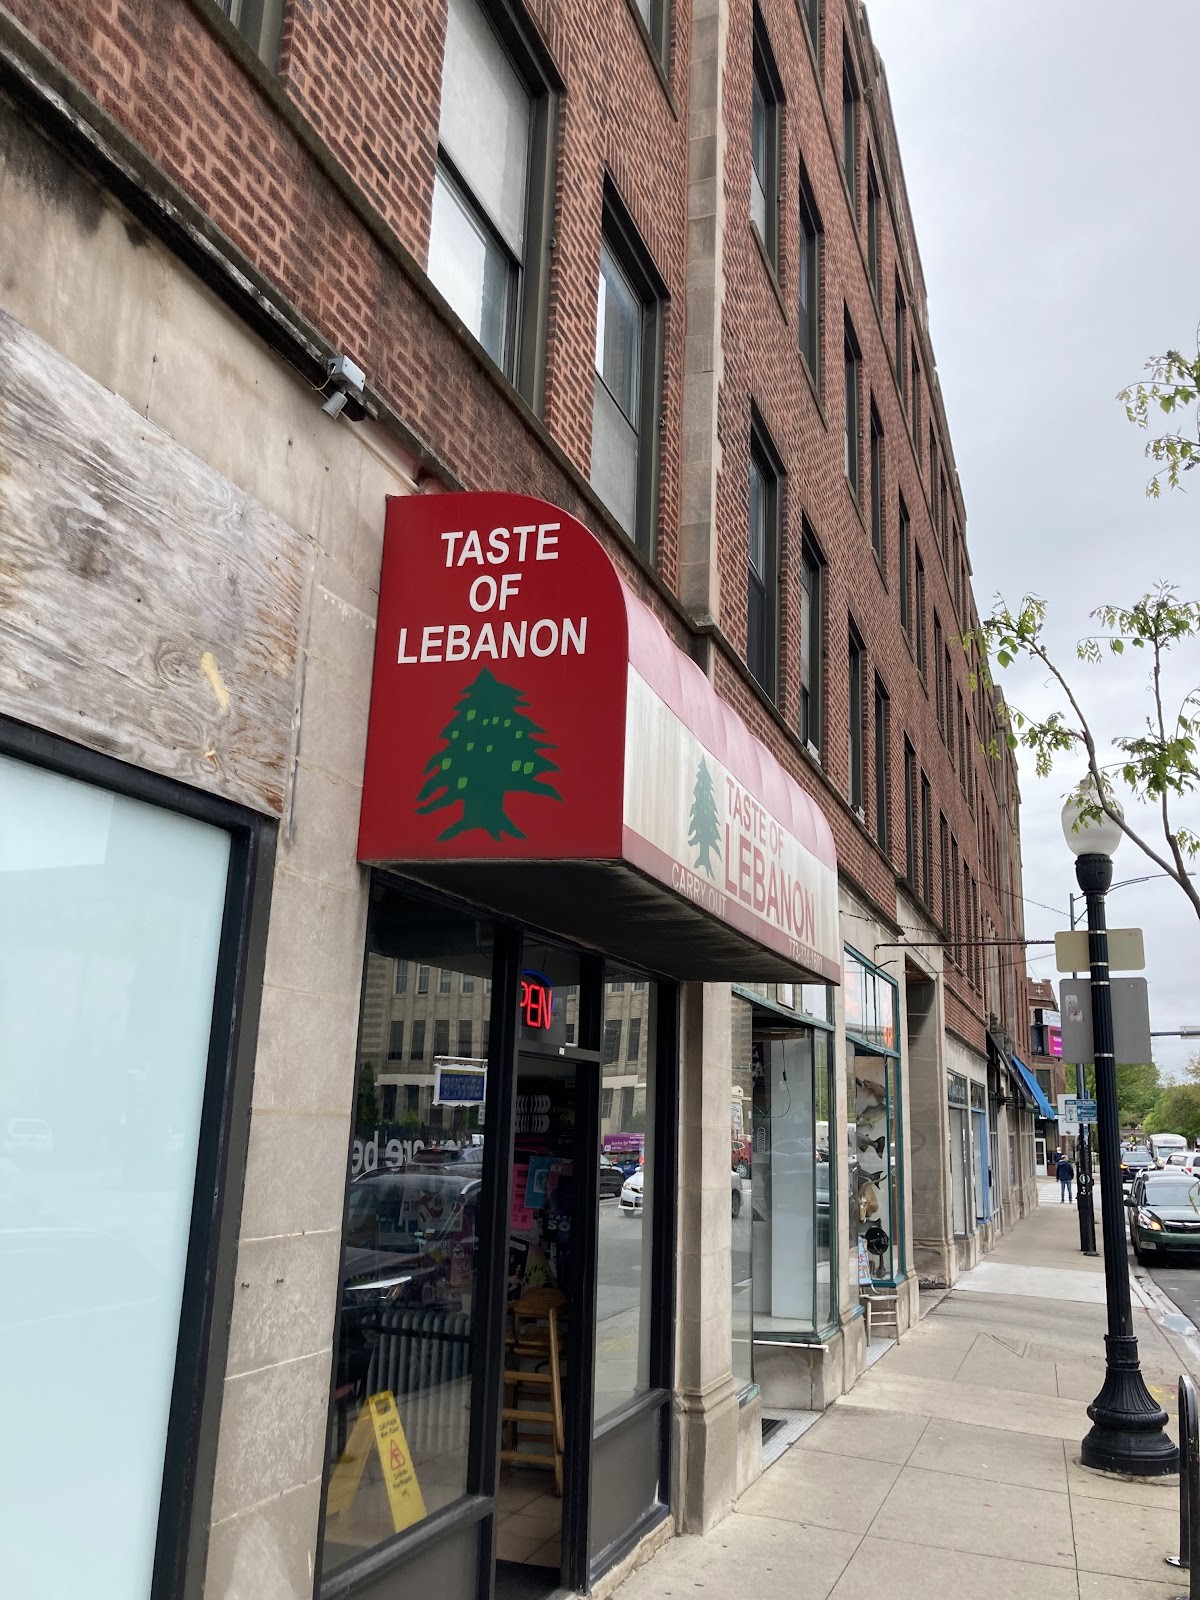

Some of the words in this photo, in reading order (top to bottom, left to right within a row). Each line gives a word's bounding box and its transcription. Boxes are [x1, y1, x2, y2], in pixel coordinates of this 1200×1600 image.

[440, 523, 561, 568] TASTE
[469, 573, 523, 613] OF
[397, 616, 588, 664] LEBANON
[725, 775, 767, 847] TASTE
[769, 820, 784, 859] OF
[671, 862, 707, 908] CARRY
[708, 888, 727, 919] OUT
[724, 822, 816, 947] LEBANON
[519, 981, 553, 1030] PEN
